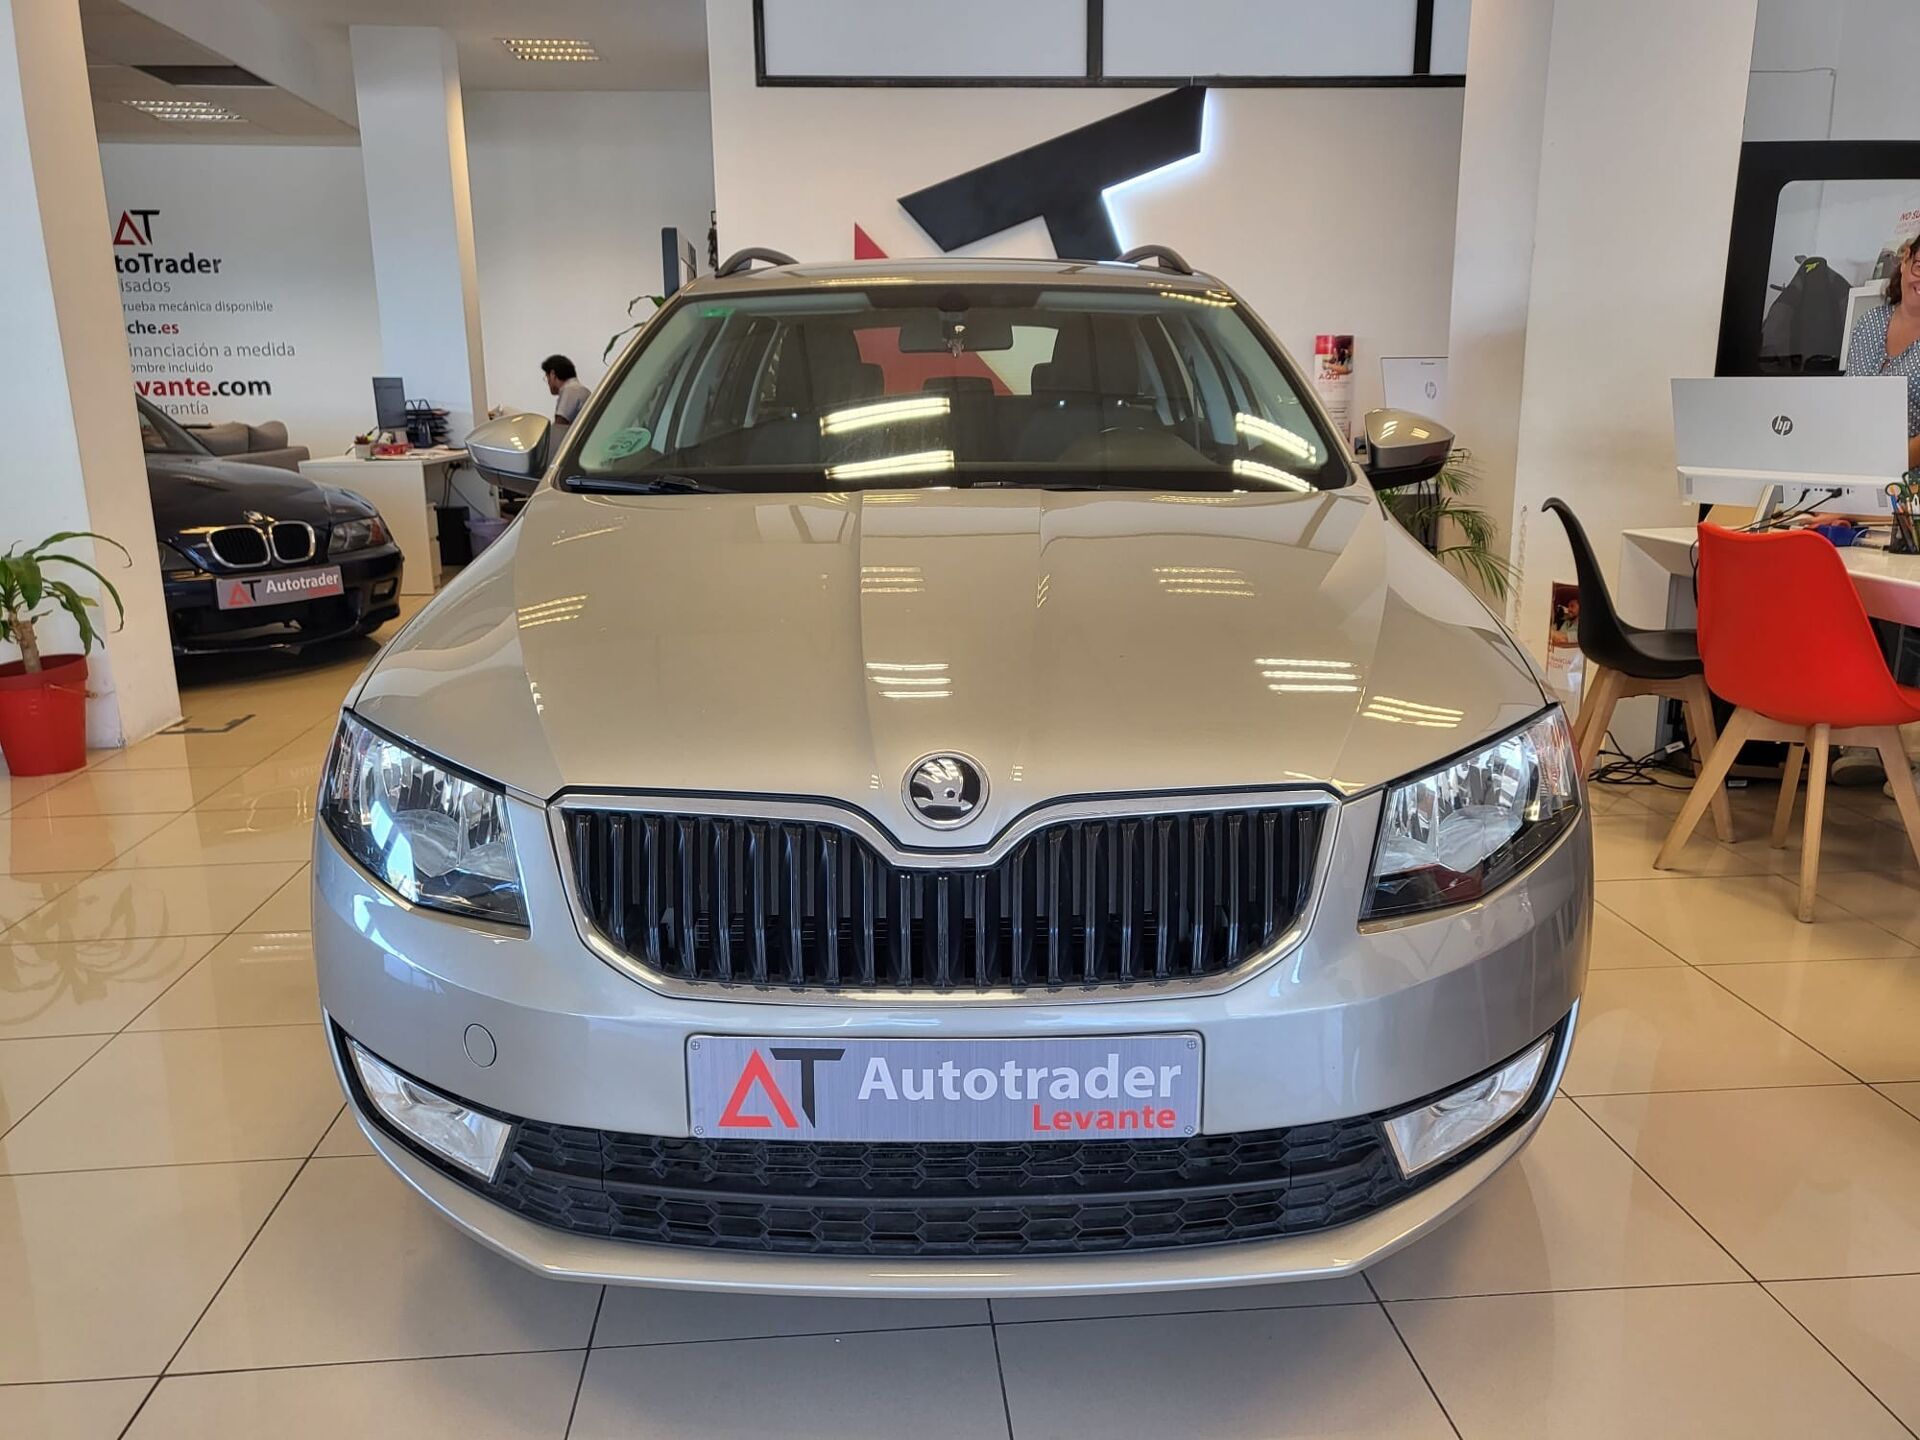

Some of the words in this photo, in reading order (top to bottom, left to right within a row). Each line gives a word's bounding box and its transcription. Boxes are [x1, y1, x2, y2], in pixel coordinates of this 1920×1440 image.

[114, 252, 222, 274] toTrader
[121, 278, 171, 293] isados
[159, 301, 212, 312] mecánica
[215, 300, 273, 314] disponible
[127, 320, 179, 334] che.es
[129, 342, 219, 358] inanciación
[224, 346, 232, 357] a
[237, 342, 296, 357] medida
[168, 361, 213, 374] incluido
[135, 378, 271, 396] vante.com
[1772, 415, 1793, 436] hp
[266, 573, 339, 594] Autotrader
[857, 1053, 1182, 1102] Autotrader
[1032, 1104, 1176, 1131] Levante
